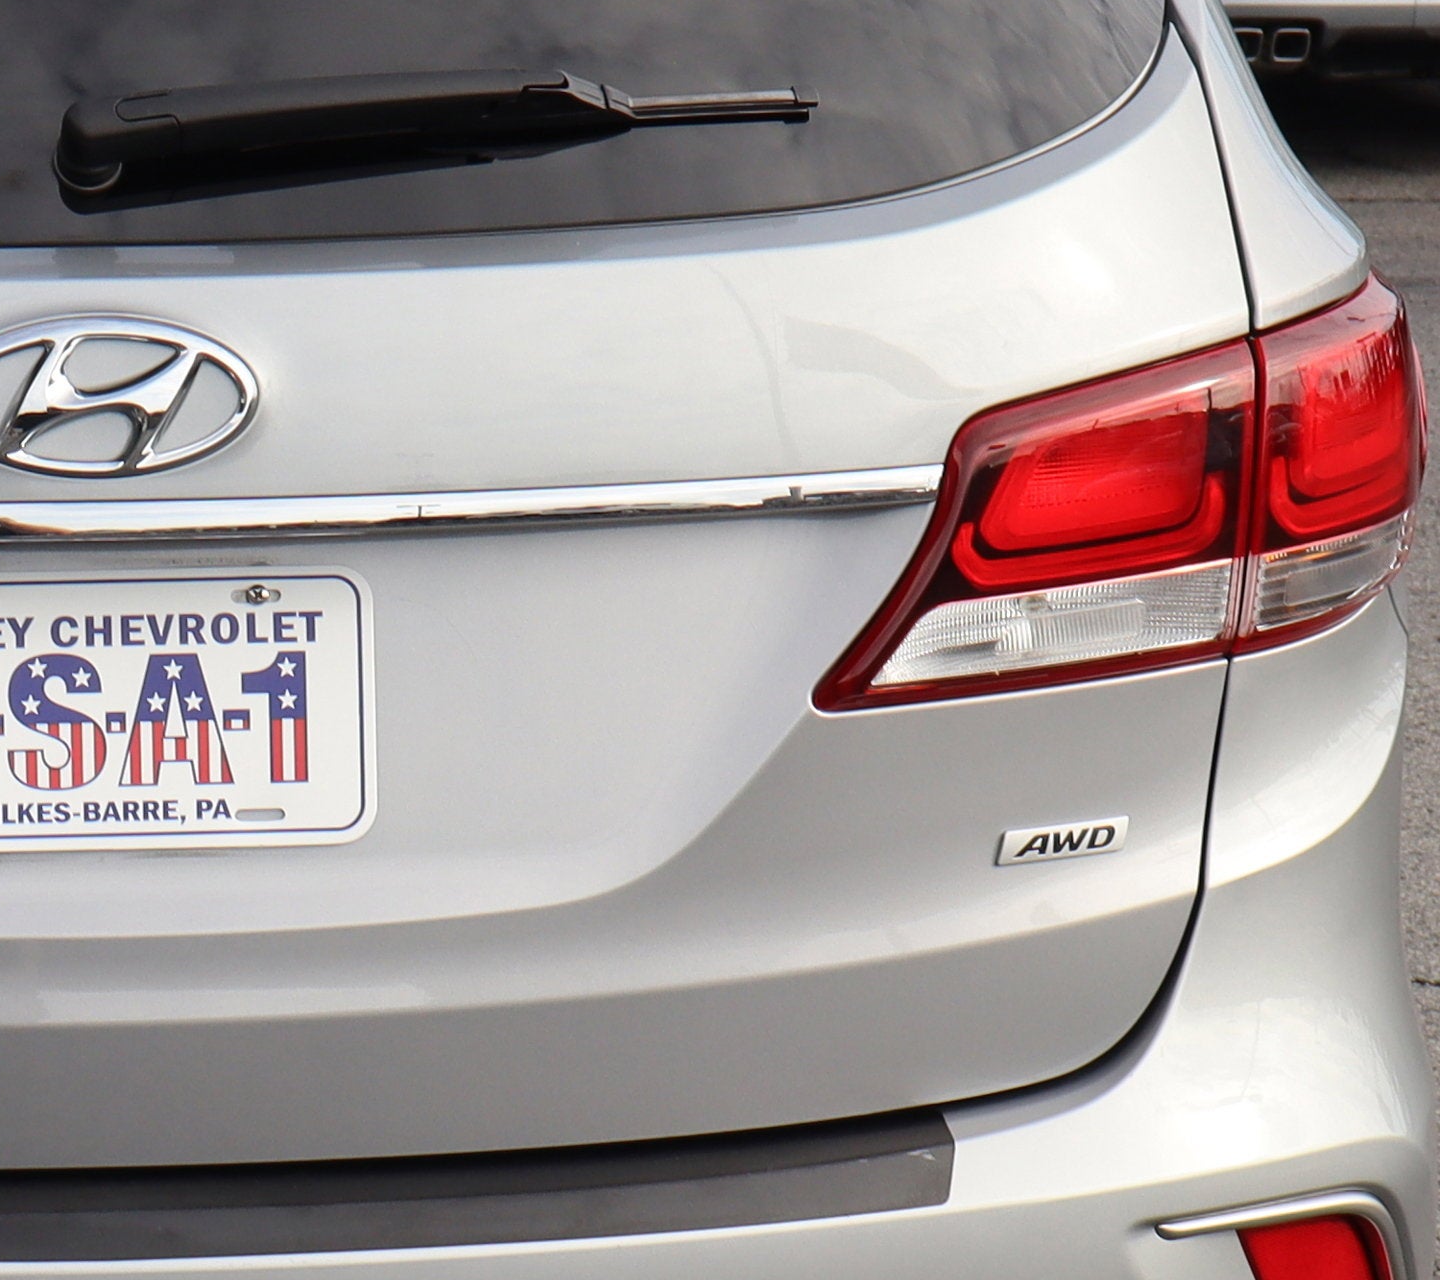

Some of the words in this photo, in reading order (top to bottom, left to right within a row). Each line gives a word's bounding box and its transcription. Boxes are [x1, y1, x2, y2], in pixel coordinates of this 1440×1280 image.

[50, 611, 323, 648] CHEVROLET
[196, 799, 233, 823] PA
[1014, 825, 1116, 857] AWD
